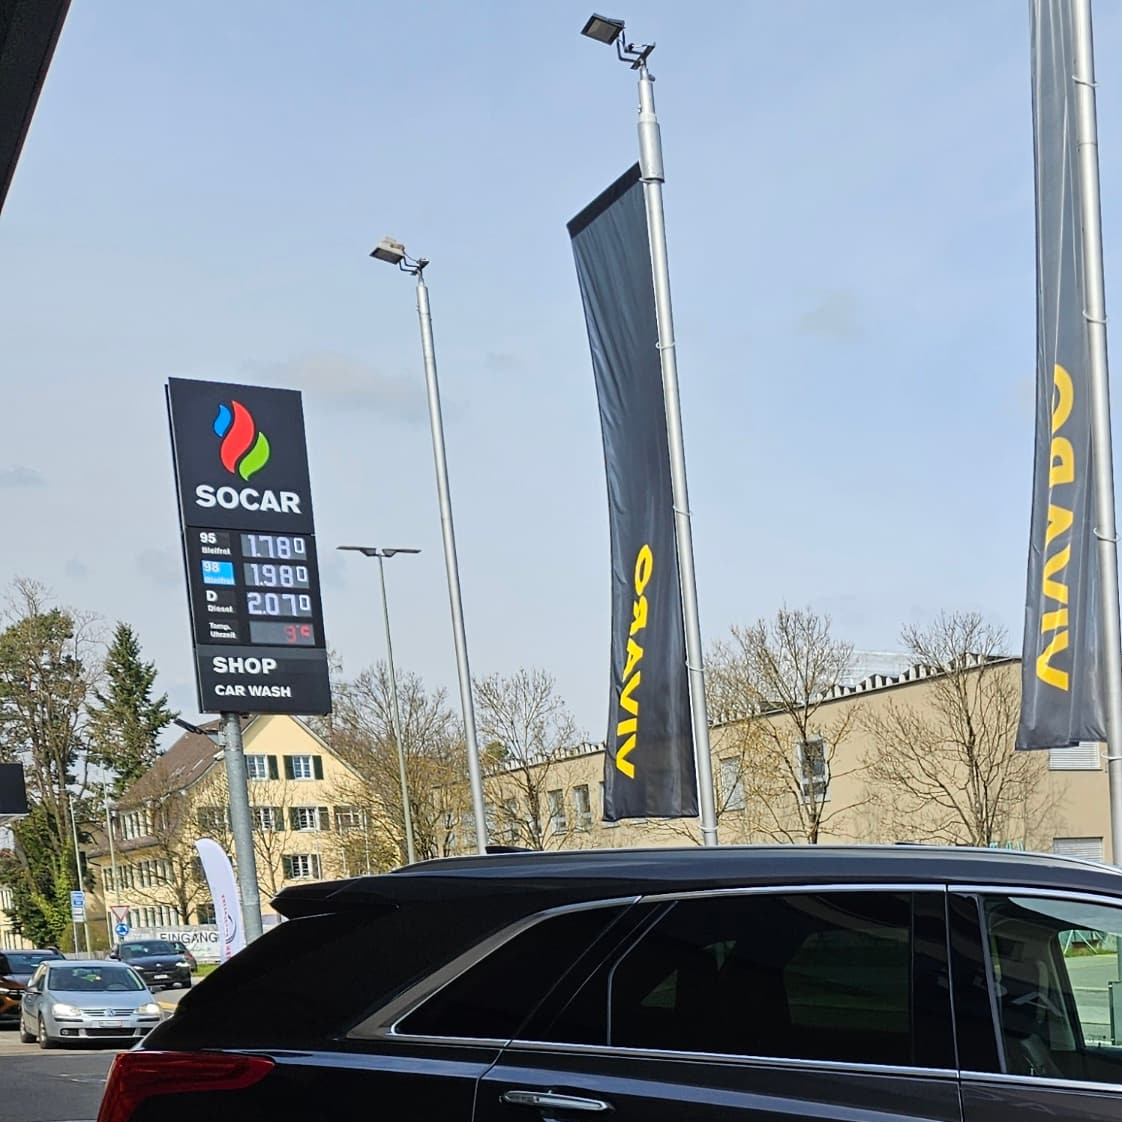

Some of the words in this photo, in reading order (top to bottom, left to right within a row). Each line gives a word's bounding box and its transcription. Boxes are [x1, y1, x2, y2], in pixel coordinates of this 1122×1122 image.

[195, 484, 302, 514] SOCAR
[199, 532, 217, 544] 95
[203, 561, 220, 572] 98
[205, 590, 218, 602] D
[207, 604, 234, 613] Diesel
[212, 656, 278, 675] SHOP
[214, 684, 246, 697] CAR
[248, 685, 292, 698] WASH
[160, 932, 218, 944] EINGANG
